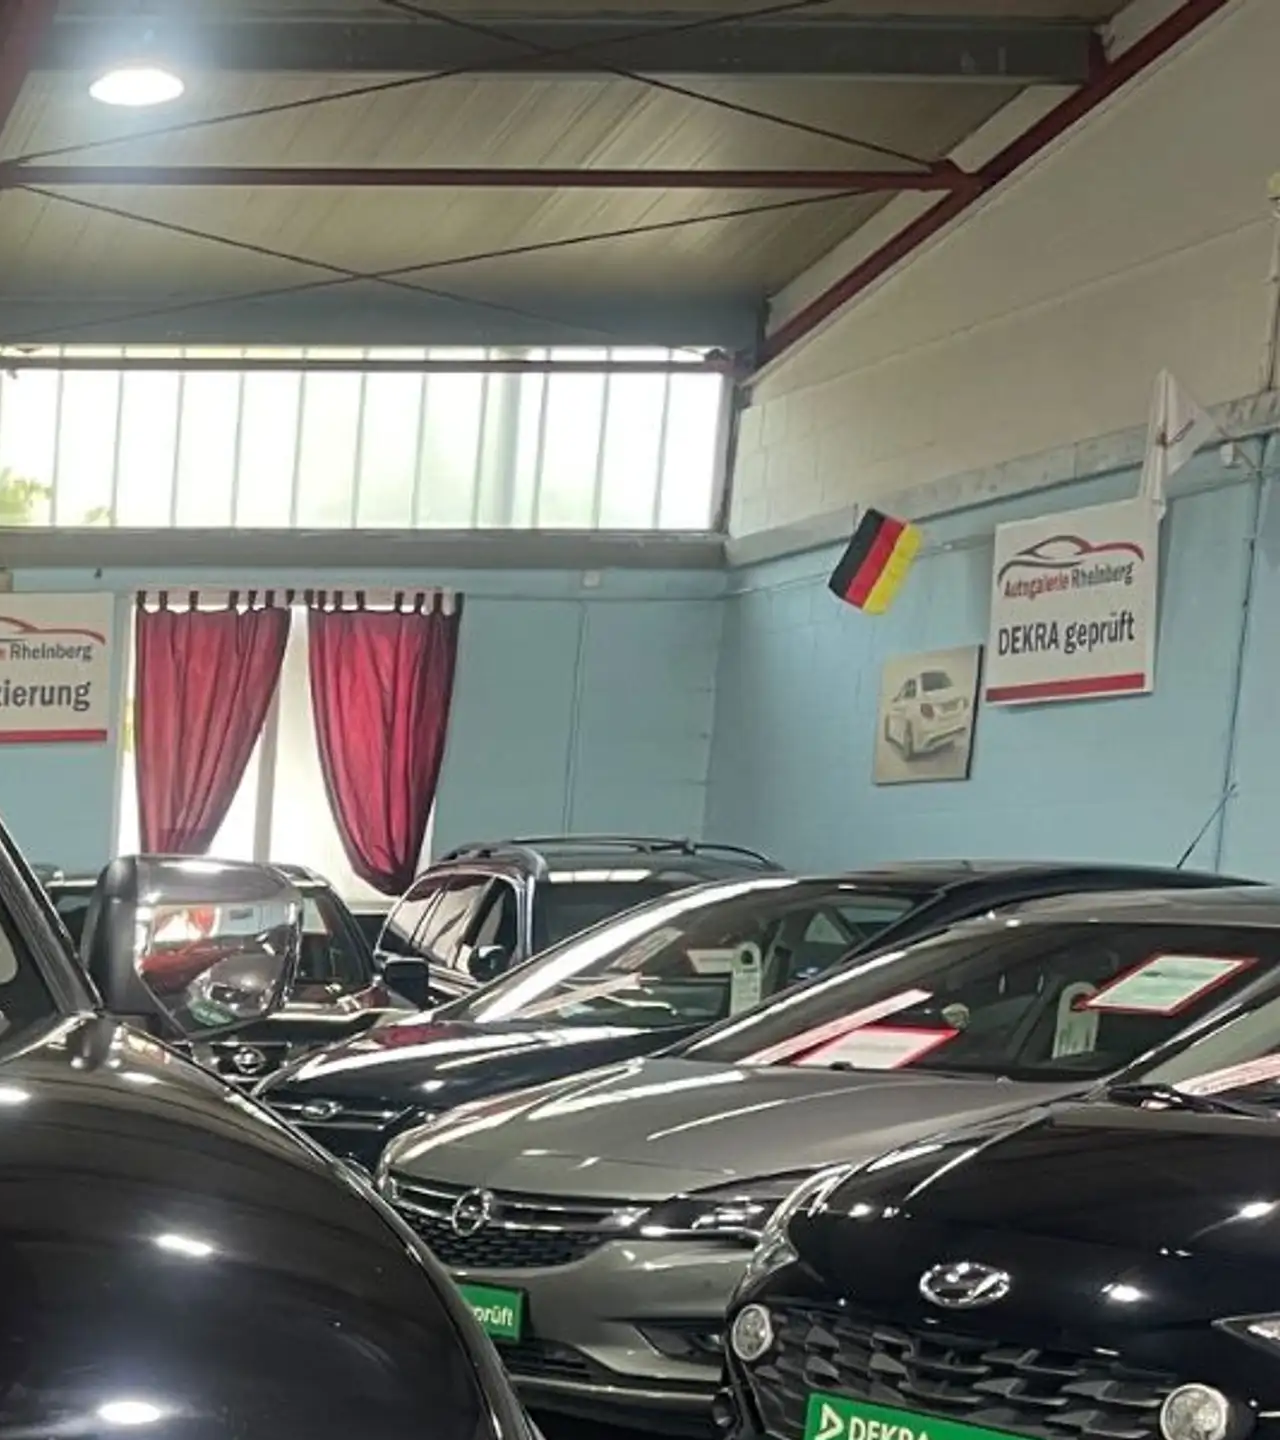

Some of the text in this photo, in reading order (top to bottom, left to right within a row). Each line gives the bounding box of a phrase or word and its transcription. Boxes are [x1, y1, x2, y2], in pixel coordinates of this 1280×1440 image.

[1002, 561, 1135, 600] Autogalerie Rheinberg
[997, 611, 1136, 657] DEKRA geprüft
[9, 642, 93, 663] Rheinberg
[473, 1305, 514, 1327] prüft
